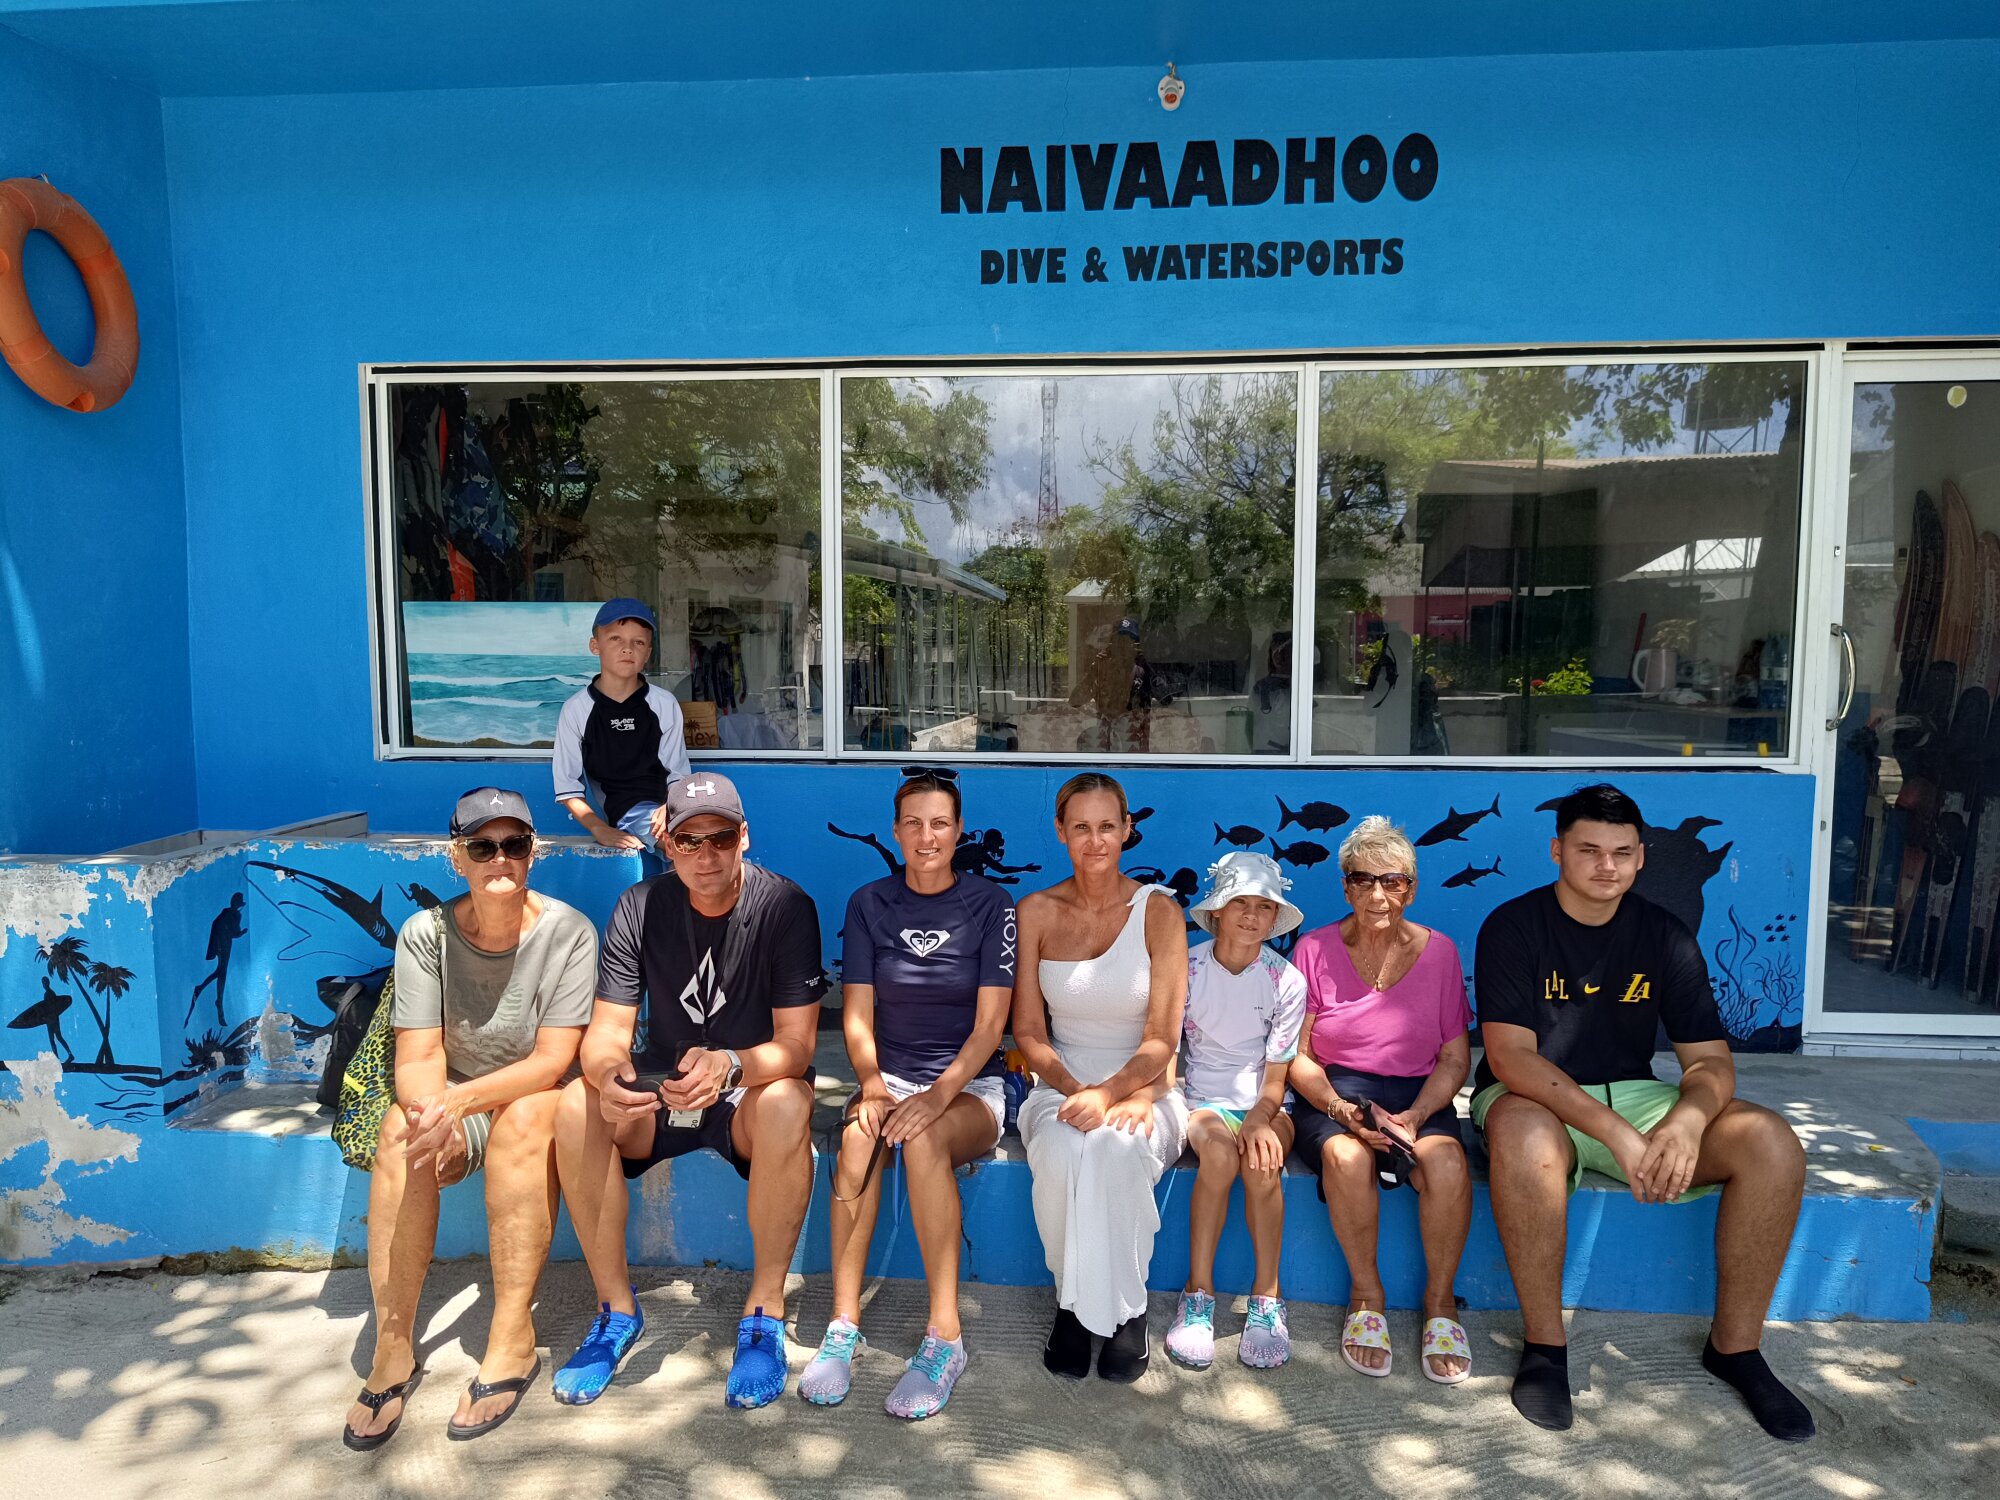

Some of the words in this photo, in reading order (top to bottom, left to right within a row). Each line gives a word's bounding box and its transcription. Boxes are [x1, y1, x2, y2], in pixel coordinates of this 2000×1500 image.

[940, 132, 1439, 214] NAIVAADHOO
[980, 247, 1067, 285] DIVE
[1082, 246, 1108, 283] &
[1122, 238, 1404, 282] WATERSPORTS
[999, 907, 1017, 976] ROXY
[1545, 970, 1569, 1000] LAL
[1618, 973, 1650, 1002] LA
